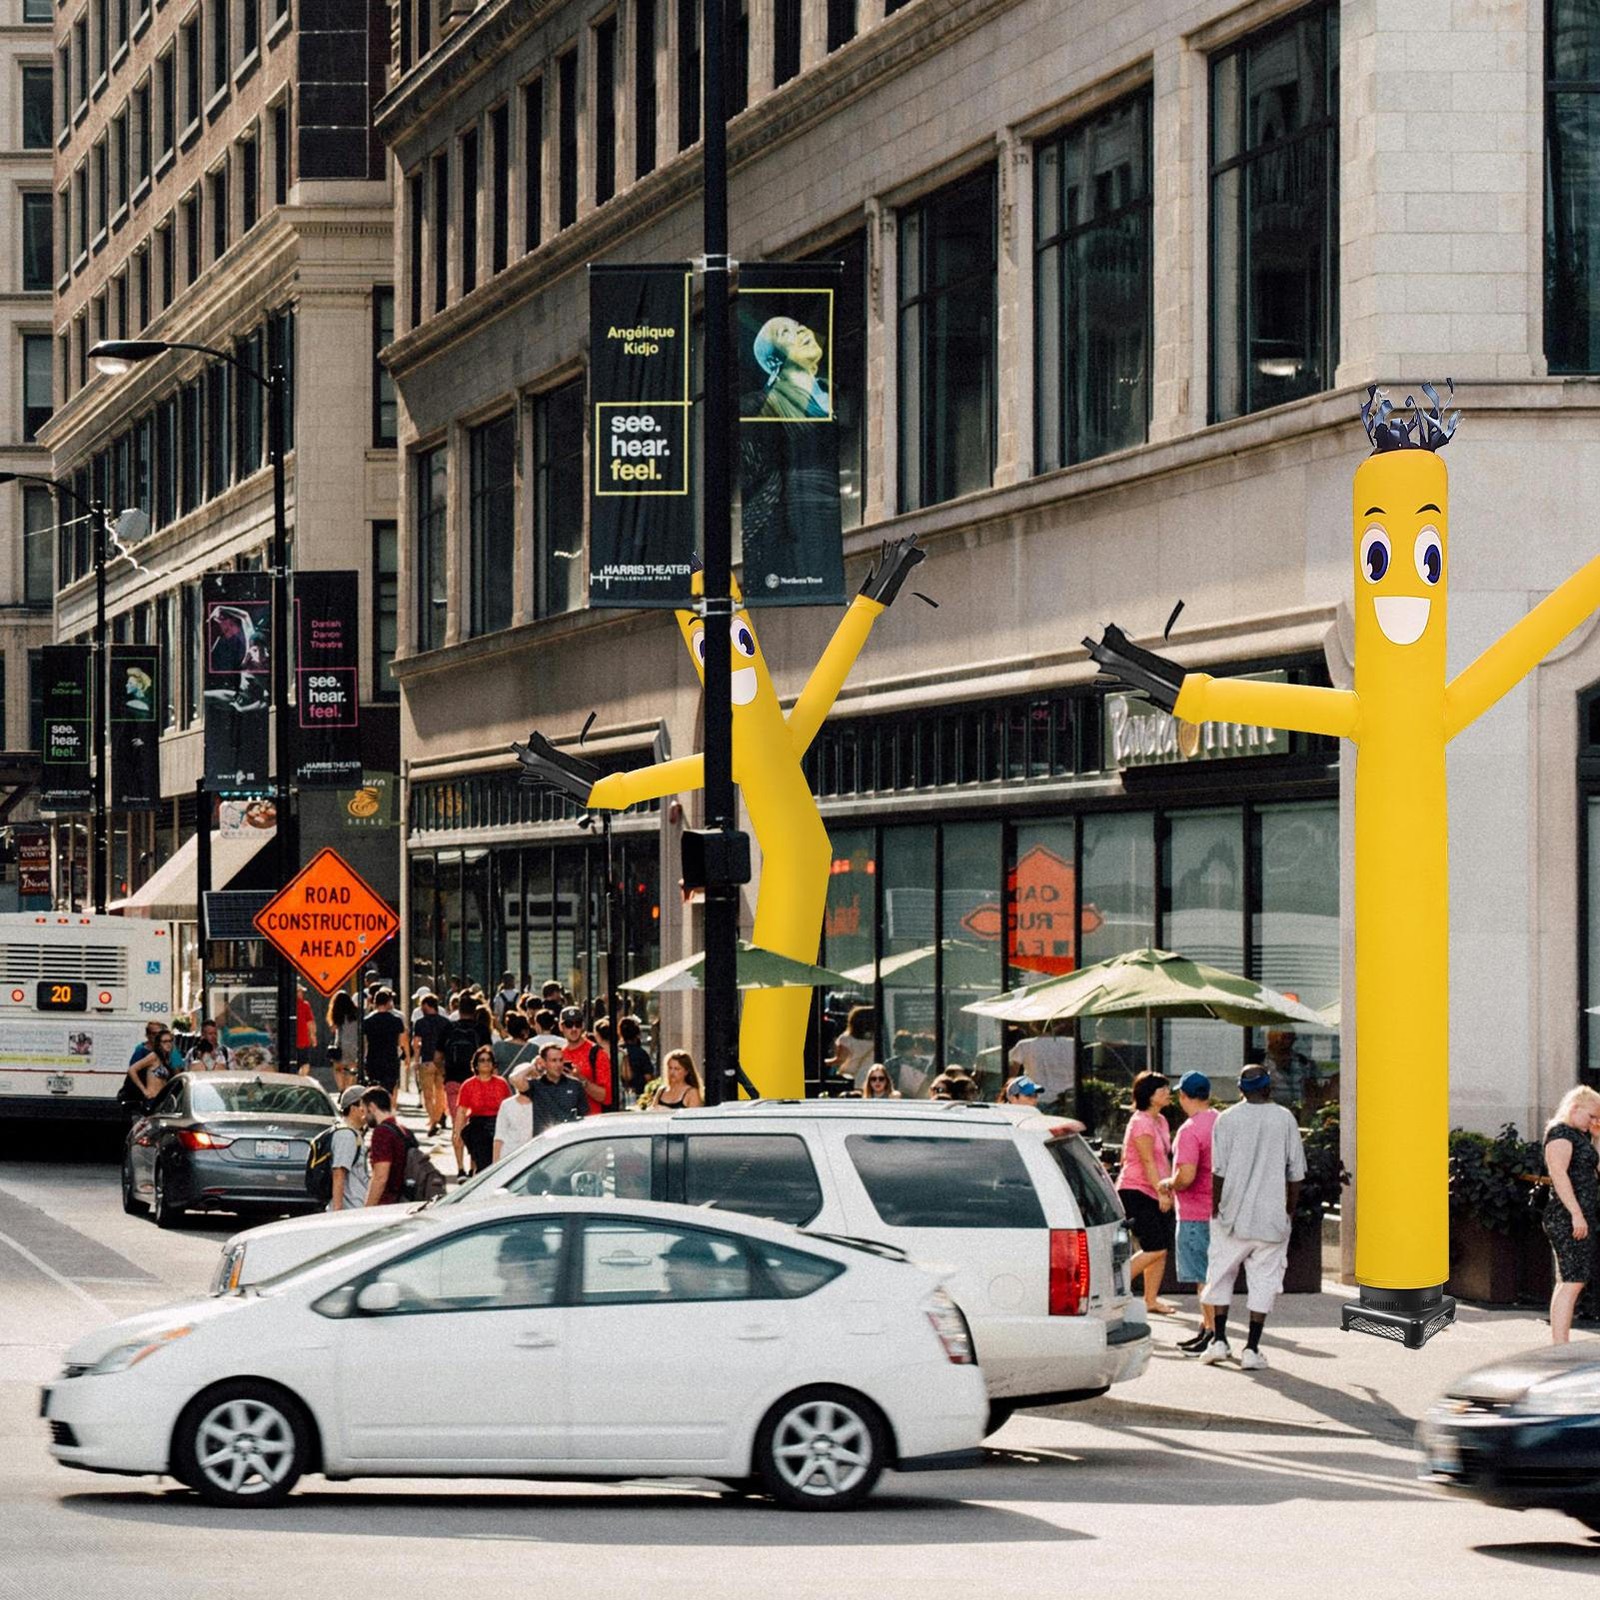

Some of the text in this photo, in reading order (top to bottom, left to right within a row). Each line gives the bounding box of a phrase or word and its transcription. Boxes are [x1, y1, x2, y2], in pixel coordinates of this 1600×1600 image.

[607, 325, 675, 344] Angélique
[624, 340, 659, 357] Kidjo
[611, 415, 662, 433] see.
[611, 434, 671, 457] hear.
[610, 458, 662, 481] feel.
[604, 564, 691, 575] HARRIS THEATER
[308, 676, 341, 688] see.
[308, 689, 347, 703] hear.
[309, 704, 342, 718] feel.
[51, 724, 76, 734] see.
[51, 735, 81, 746] hear.
[51, 746, 76, 757] feel.
[305, 886, 351, 904] ROAD
[267, 912, 389, 933] CONSTRUCTION
[301, 940, 356, 957] AHEAD
[51, 985, 71, 1003] 20
[139, 1001, 169, 1014] 1986
